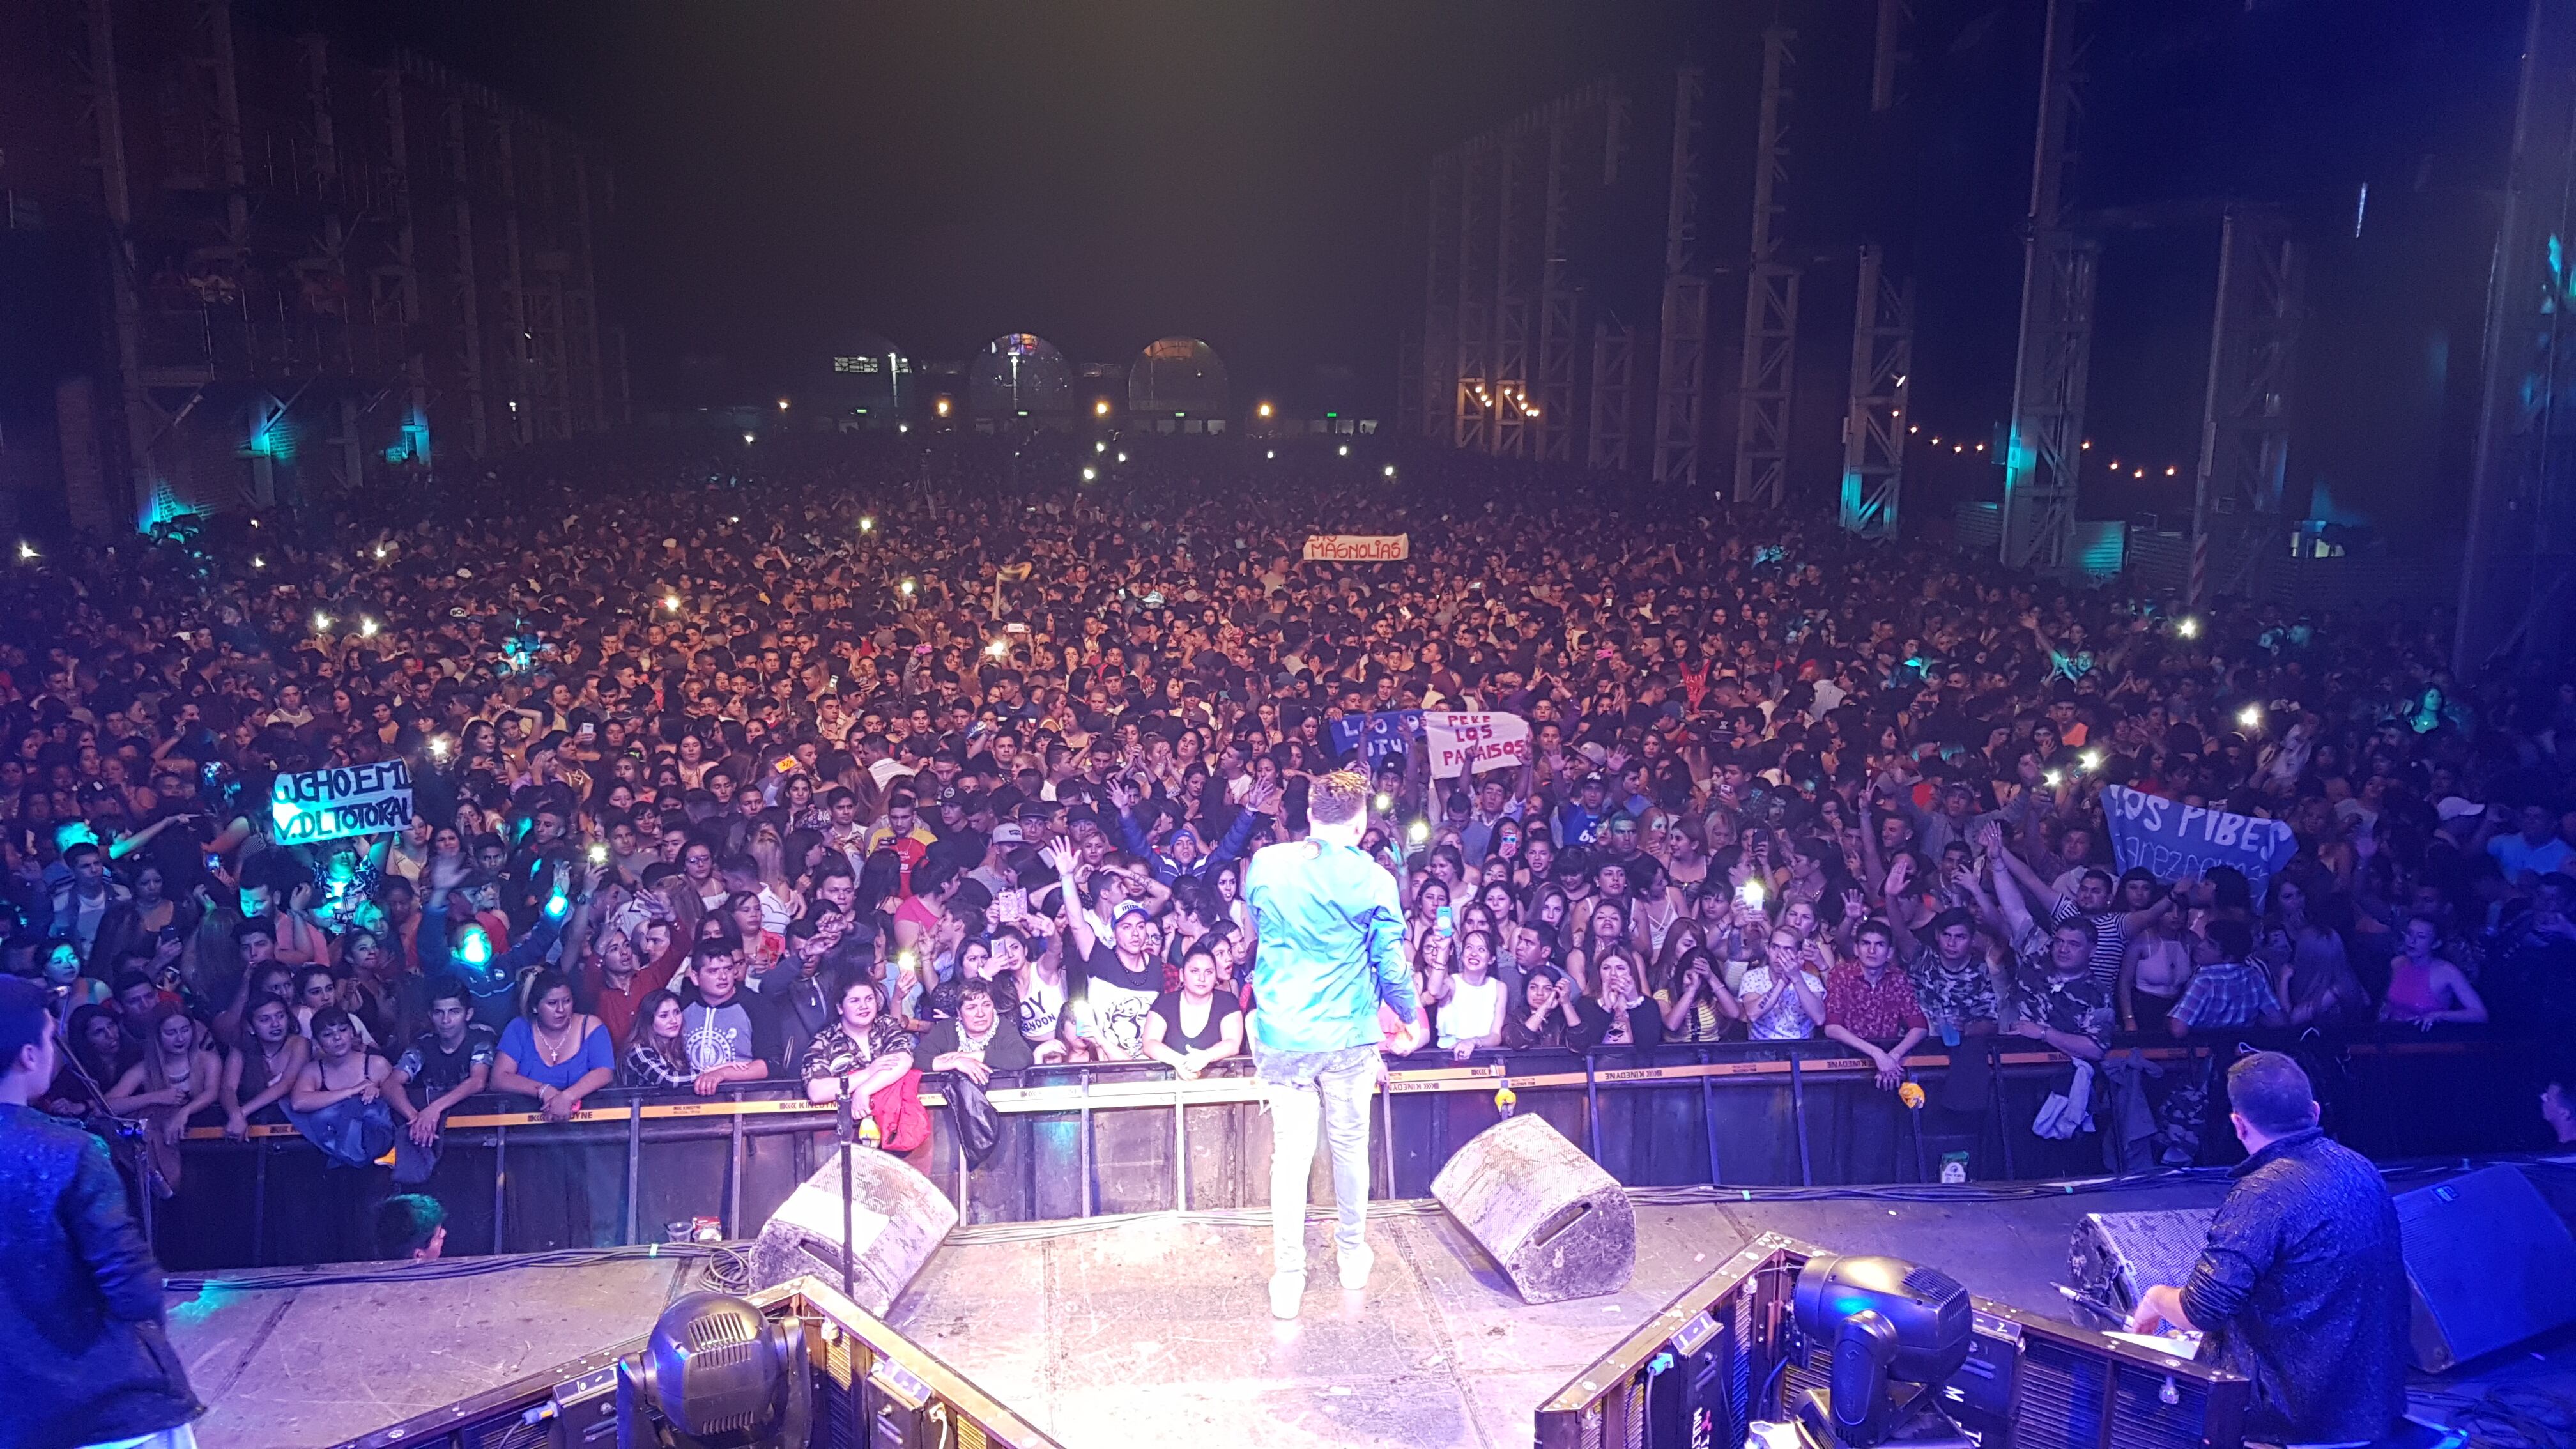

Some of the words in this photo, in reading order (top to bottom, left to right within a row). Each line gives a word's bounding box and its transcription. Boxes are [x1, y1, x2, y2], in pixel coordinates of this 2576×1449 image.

[1448, 715, 1491, 727] PEKE
[1455, 724, 1493, 742] LOS
[1443, 740, 1524, 766] PAAISOS
[2178, 804, 2293, 862] PIBES
[1605, 1071, 1644, 1080] KINEDYNE
